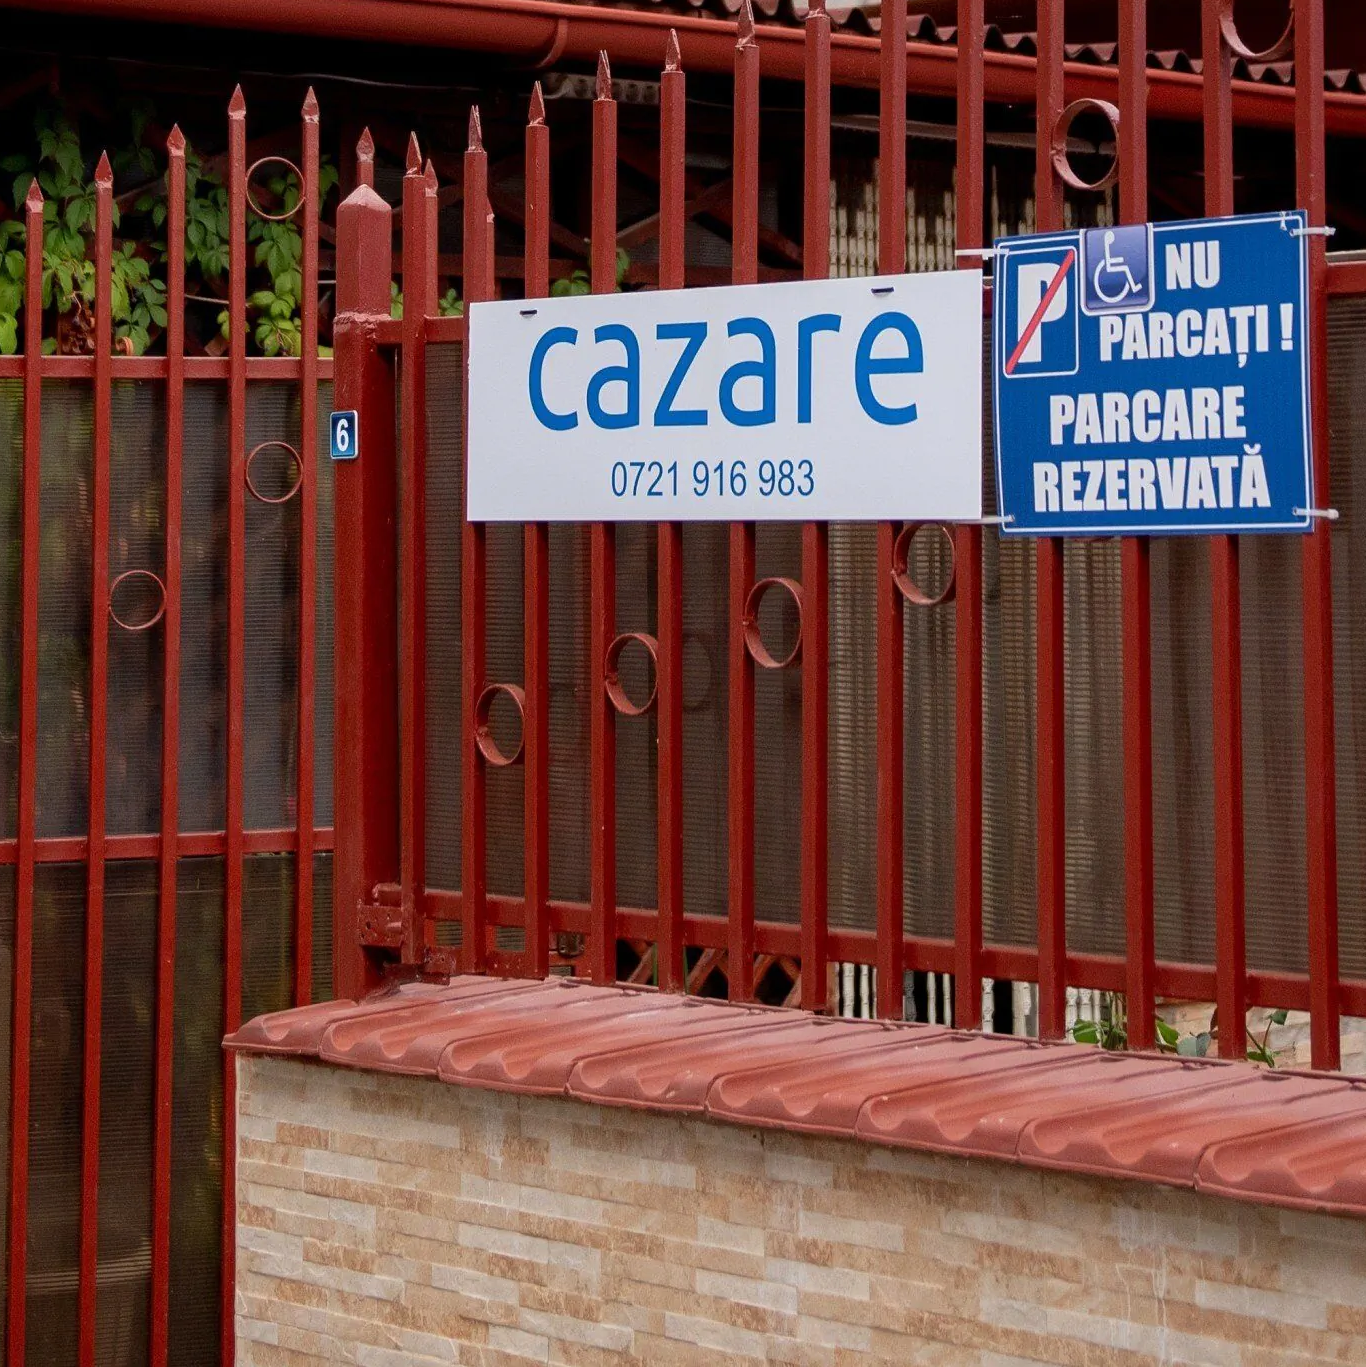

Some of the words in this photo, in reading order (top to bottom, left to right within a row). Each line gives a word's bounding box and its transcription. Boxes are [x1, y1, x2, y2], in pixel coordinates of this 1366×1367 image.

[1165, 240, 1220, 290] NU
[528, 311, 924, 431] cazare
[336, 418, 350, 452] 6
[1049, 385, 1247, 445] PARCARE
[611, 460, 679, 497] 0721
[692, 459, 747, 497] 916
[758, 458, 815, 496] 983
[1033, 443, 1272, 513] REZERVATĂ
